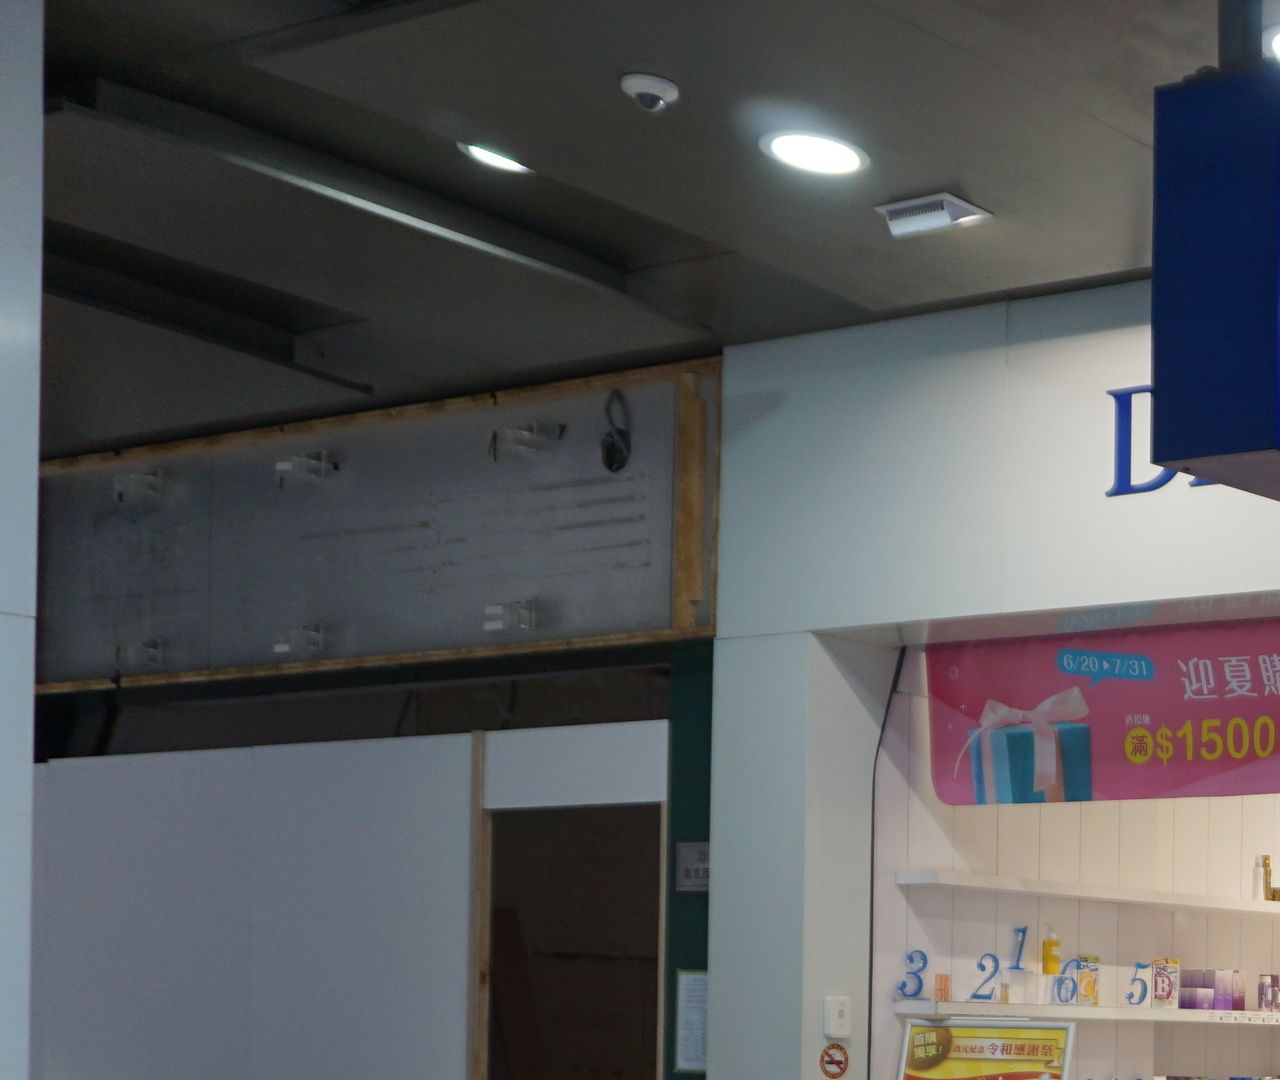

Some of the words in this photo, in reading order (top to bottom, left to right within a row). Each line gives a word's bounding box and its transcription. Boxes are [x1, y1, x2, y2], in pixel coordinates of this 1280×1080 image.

[1062, 653, 1099, 672] 6/20
[1111, 657, 1149, 676] 7/31
[898, 950, 928, 999] 3
[970, 953, 1000, 1000] 2
[1056, 959, 1083, 1003] 6
[1126, 962, 1151, 1005] 5
